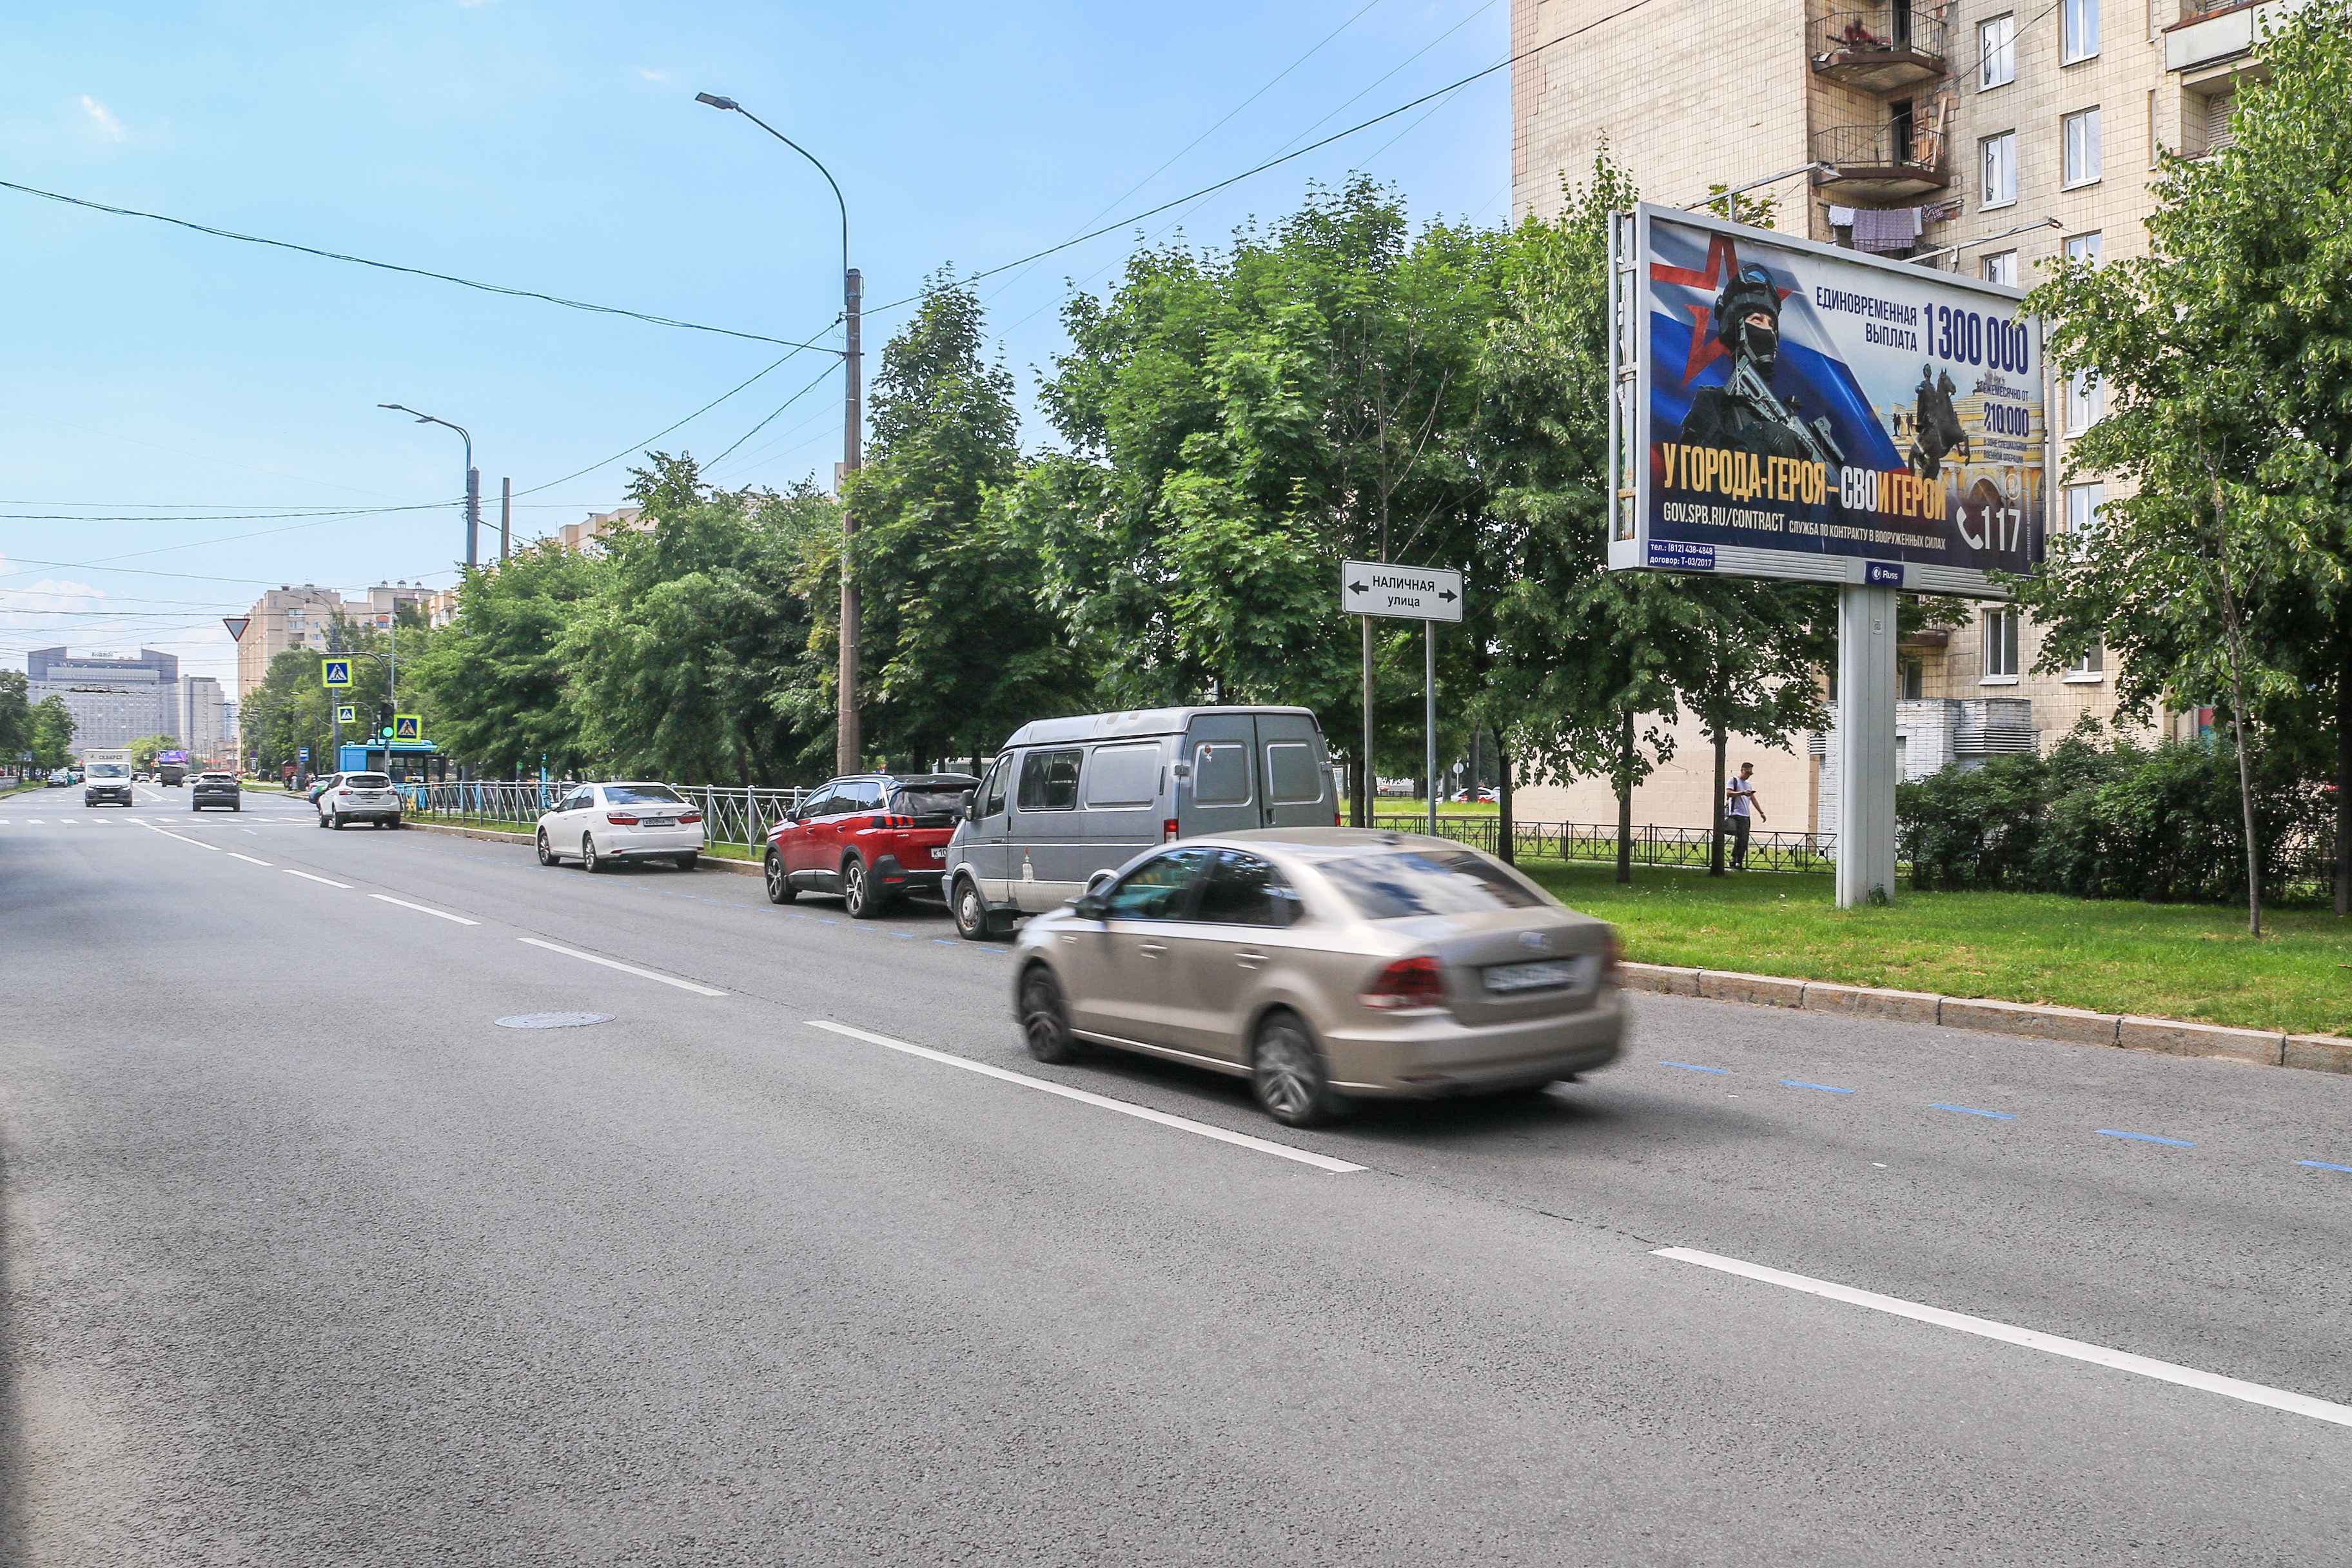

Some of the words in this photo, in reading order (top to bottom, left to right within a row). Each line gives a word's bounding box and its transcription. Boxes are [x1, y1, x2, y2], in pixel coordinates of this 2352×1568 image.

[1816, 286, 1917, 326] ЕДИНОВРЕМЕННАЯ
[1866, 323, 1917, 352] ВЫПЛАТА
[1983, 382, 2021, 400] ЕЖЕМЕСЯЧНО
[2022, 390, 2028, 402] ОТ
[1663, 443, 1676, 488] У
[1680, 444, 1826, 505] ГОРОДА-ГЕРОЯ
[1841, 466, 1889, 513] СВОИ
[1892, 473, 1946, 521] ГЕРОИ
[1663, 502, 1785, 532] GOV.SPB.RU/CONTRACT
[1981, 505, 2021, 552] 117
[1668, 543, 1684, 553] (812)
[1685, 545, 1713, 555] 438-4848
[1789, 520, 1819, 535] СЛУЖБА
[1820, 524, 1828, 536] ПО
[1830, 525, 1868, 542] КОНТРАКТУ
[1869, 529, 1874, 542] В
[1875, 530, 1924, 547] ВООРУЖЕННЫХ
[1925, 536, 1946, 551] СИЛАХ
[1649, 556, 1680, 566] договор:
[1681, 556, 1712, 567] Т-03/2017
[1373, 575, 1435, 592] НАЛИЧНАЯ
[1387, 596, 1420, 608] улица
